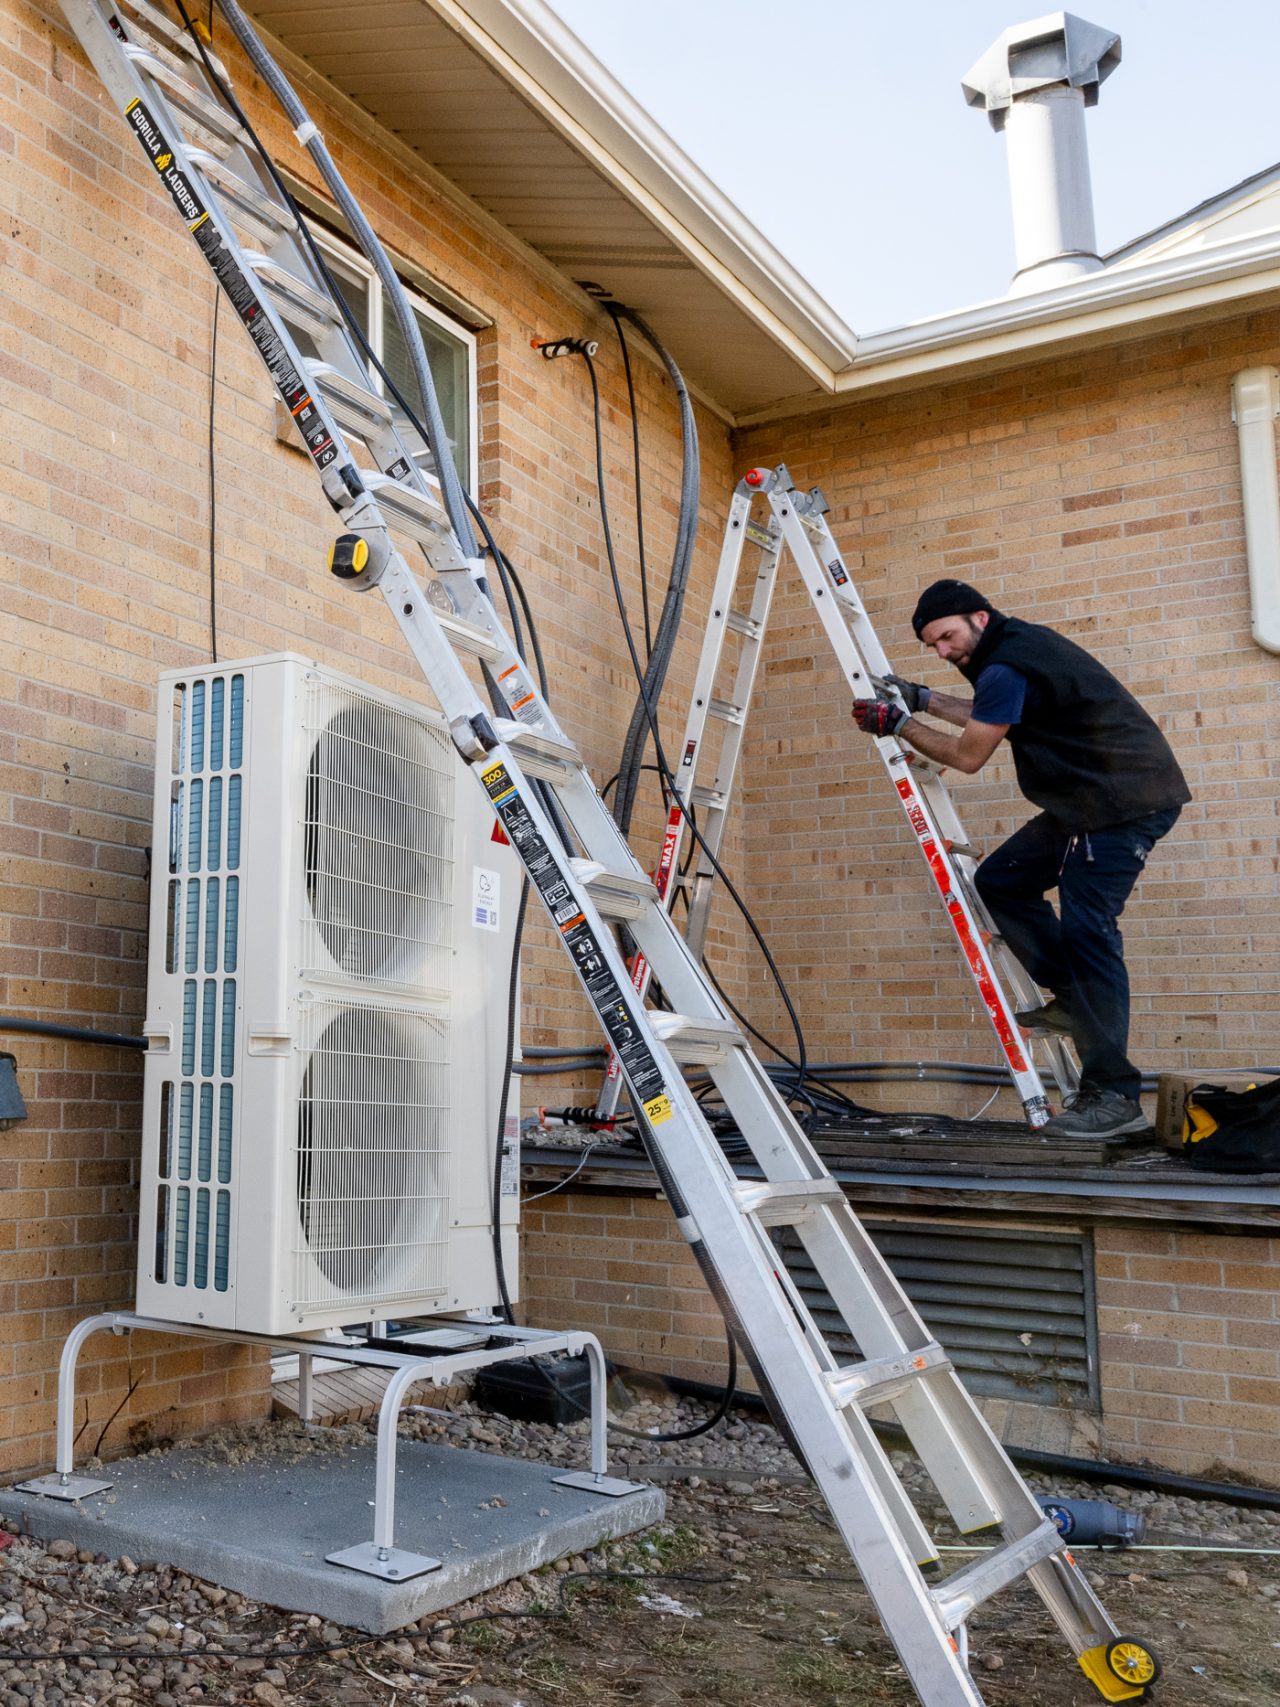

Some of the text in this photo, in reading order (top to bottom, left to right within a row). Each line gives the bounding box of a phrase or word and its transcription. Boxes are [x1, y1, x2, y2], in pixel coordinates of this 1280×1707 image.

[131, 107, 199, 219] GORILLA LADDERS
[483, 769, 501, 785] 300
[648, 1103, 661, 1116] 25
